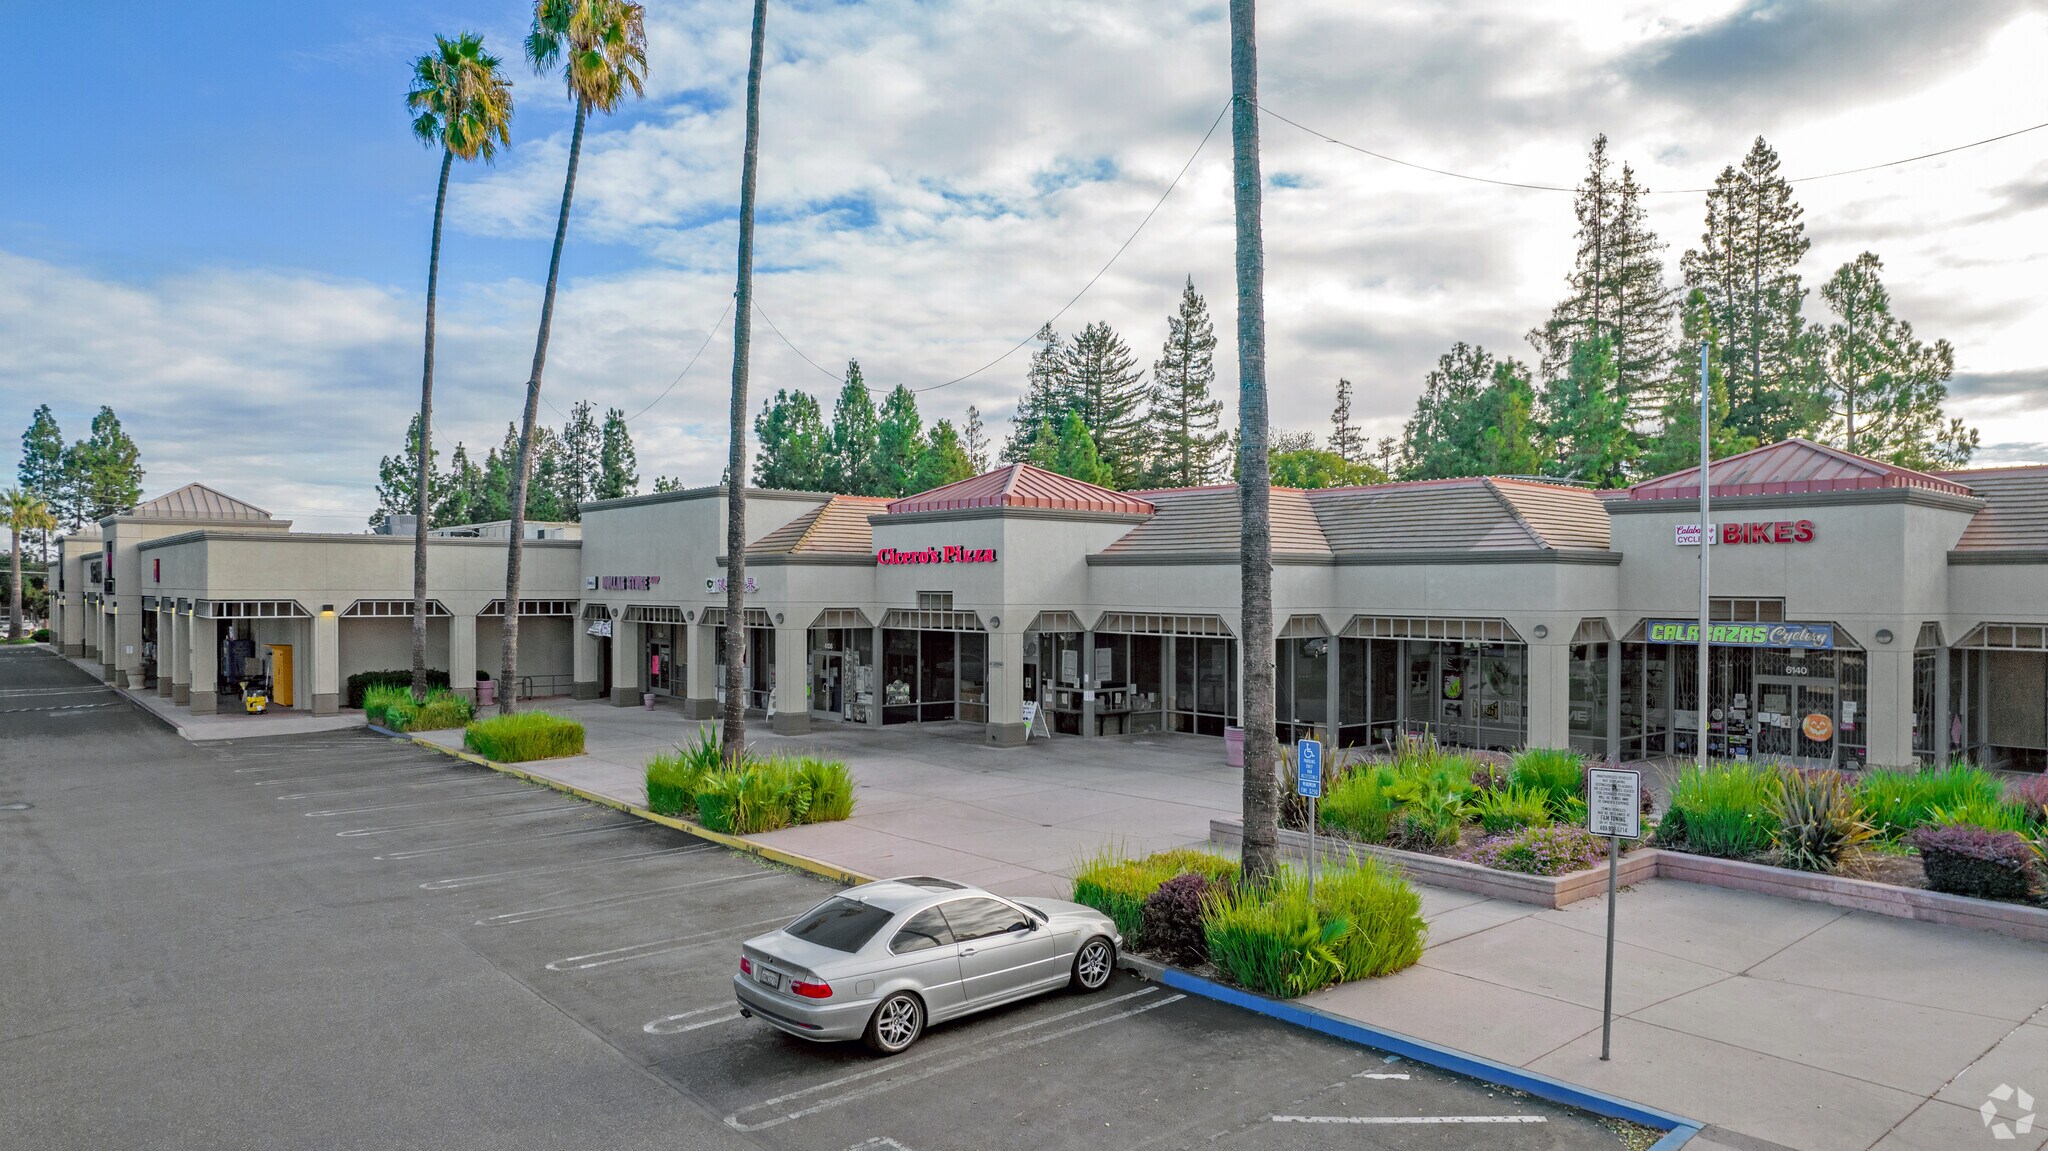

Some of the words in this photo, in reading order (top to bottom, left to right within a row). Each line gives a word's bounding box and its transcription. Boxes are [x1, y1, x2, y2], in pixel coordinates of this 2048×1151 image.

[1676, 524, 1714, 535] Calabas
[1723, 520, 1815, 544] BIKES
[878, 546, 941, 564] Cicero's
[943, 545, 997, 563] Pizza
[1786, 666, 1808, 674] 6140
